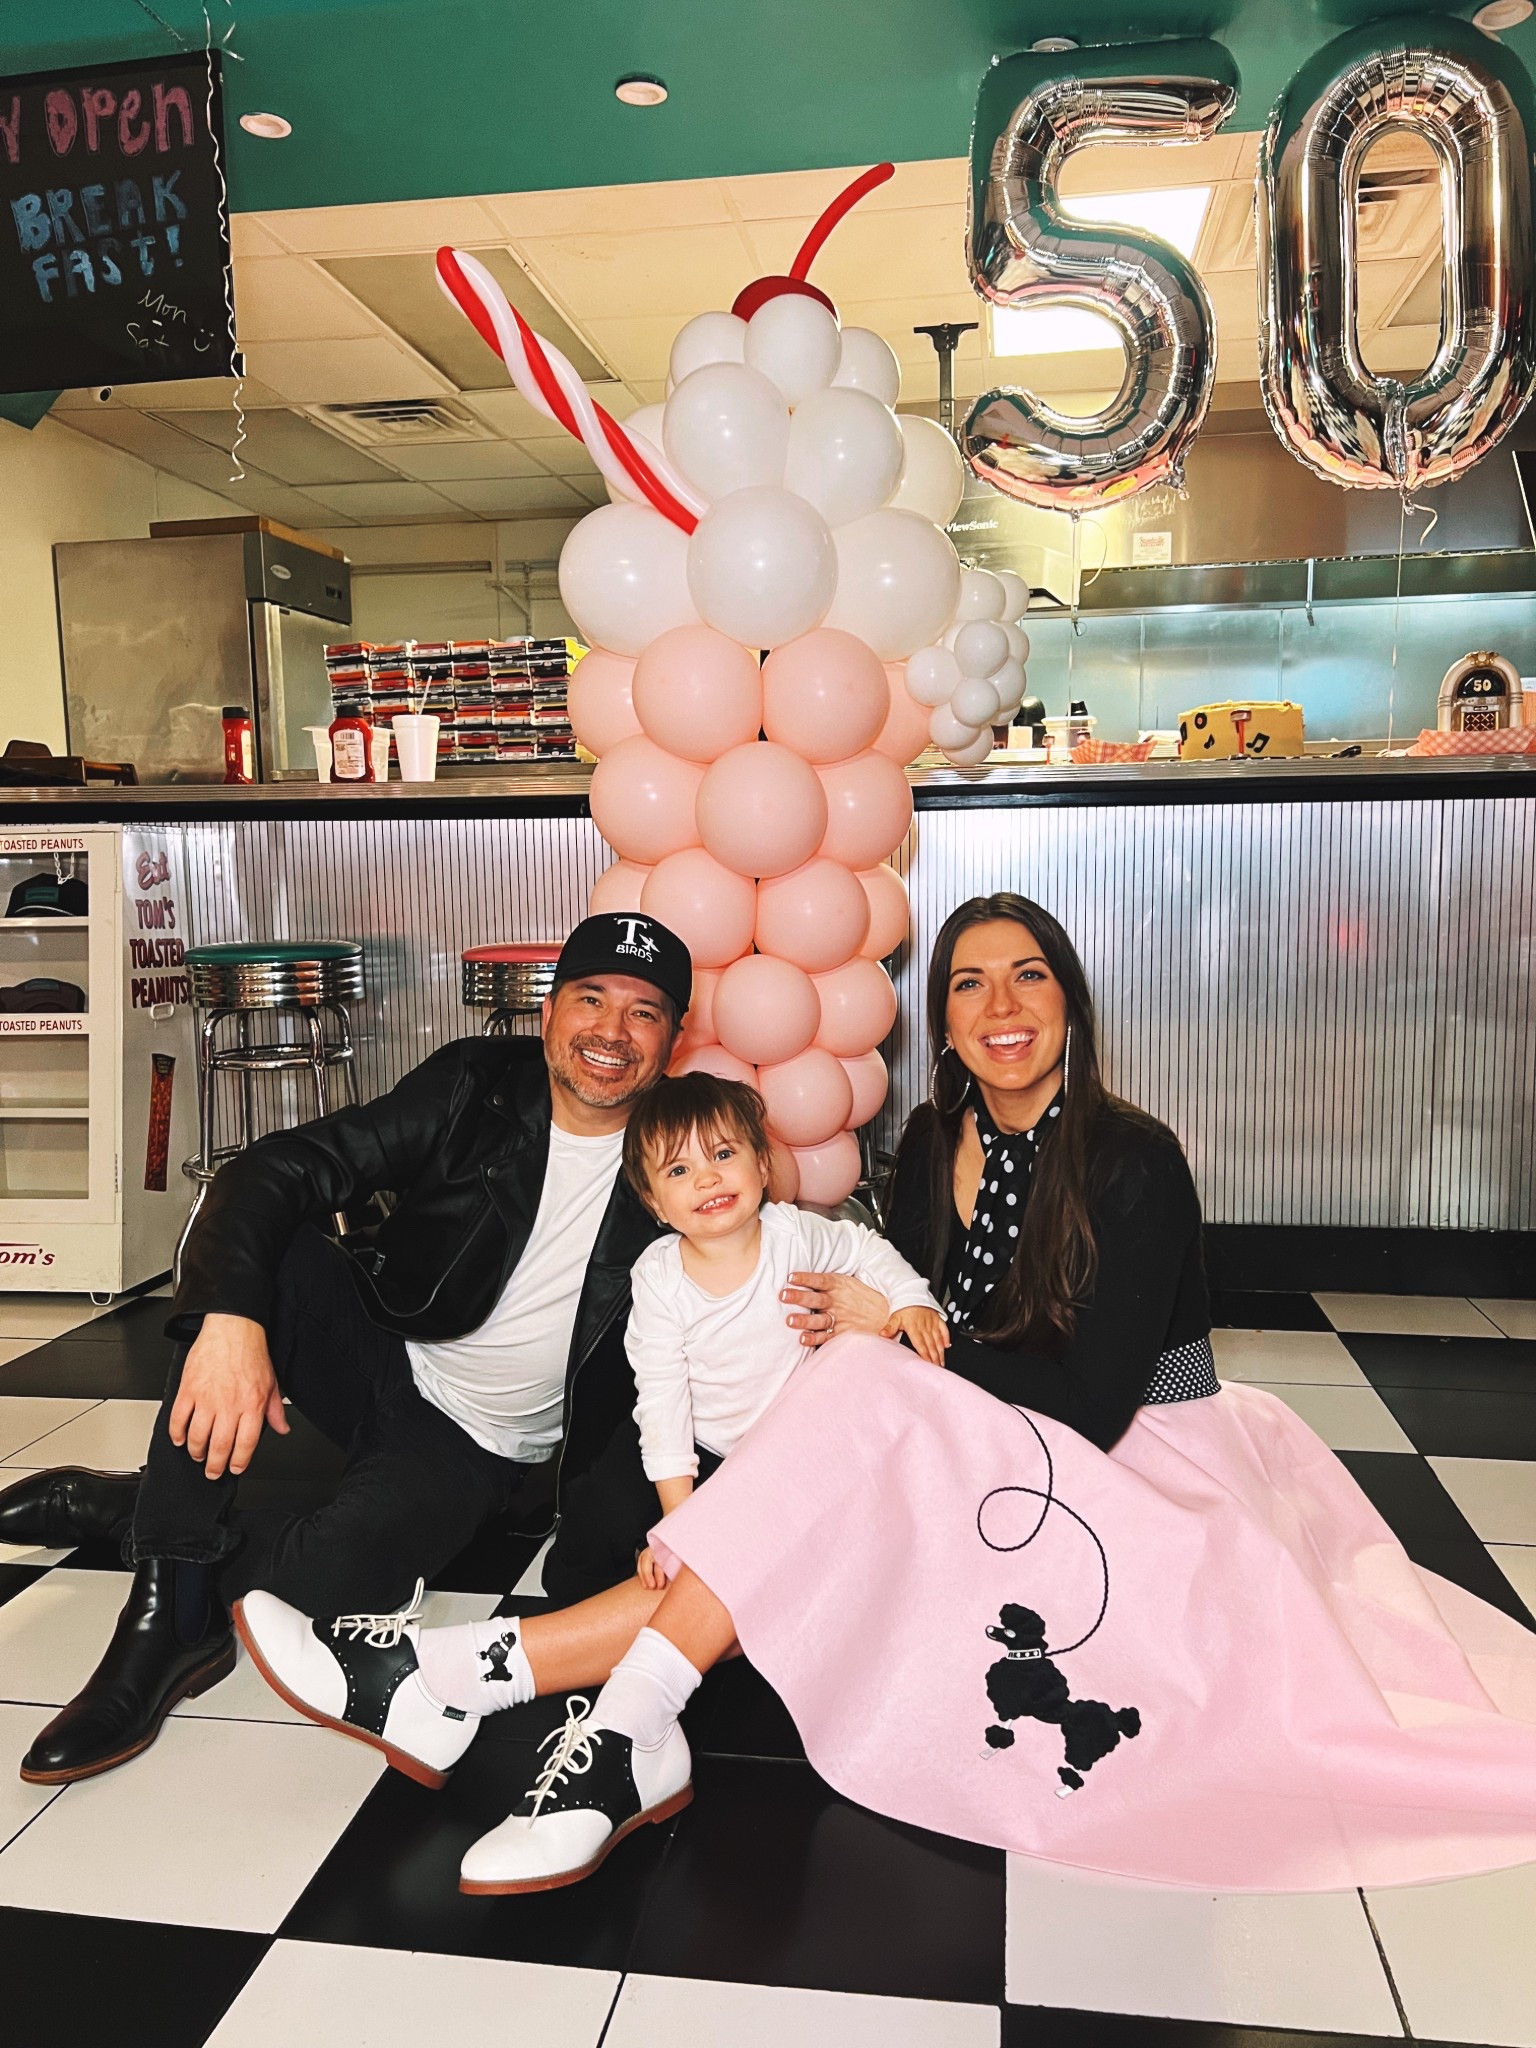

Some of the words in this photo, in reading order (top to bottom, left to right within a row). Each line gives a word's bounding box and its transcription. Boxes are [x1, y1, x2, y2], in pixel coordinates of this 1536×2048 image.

[10, 170, 187, 252] BREAK
[137, 289, 187, 323] Mon
[126, 322, 170, 348] Sat
[946, 519, 999, 532] ViewSonic
[1473, 679, 1492, 692] 50
[41, 838, 84, 849] PEANUTS
[136, 851, 171, 890] Eat
[135, 896, 176, 930] TOM'S
[129, 938, 185, 969] TOASTED
[615, 944, 653, 963] BIRDS
[131, 975, 189, 1009] PEANUTS
[39, 1019, 83, 1030] PEANUTS
[0, 1243, 56, 1266] om's
